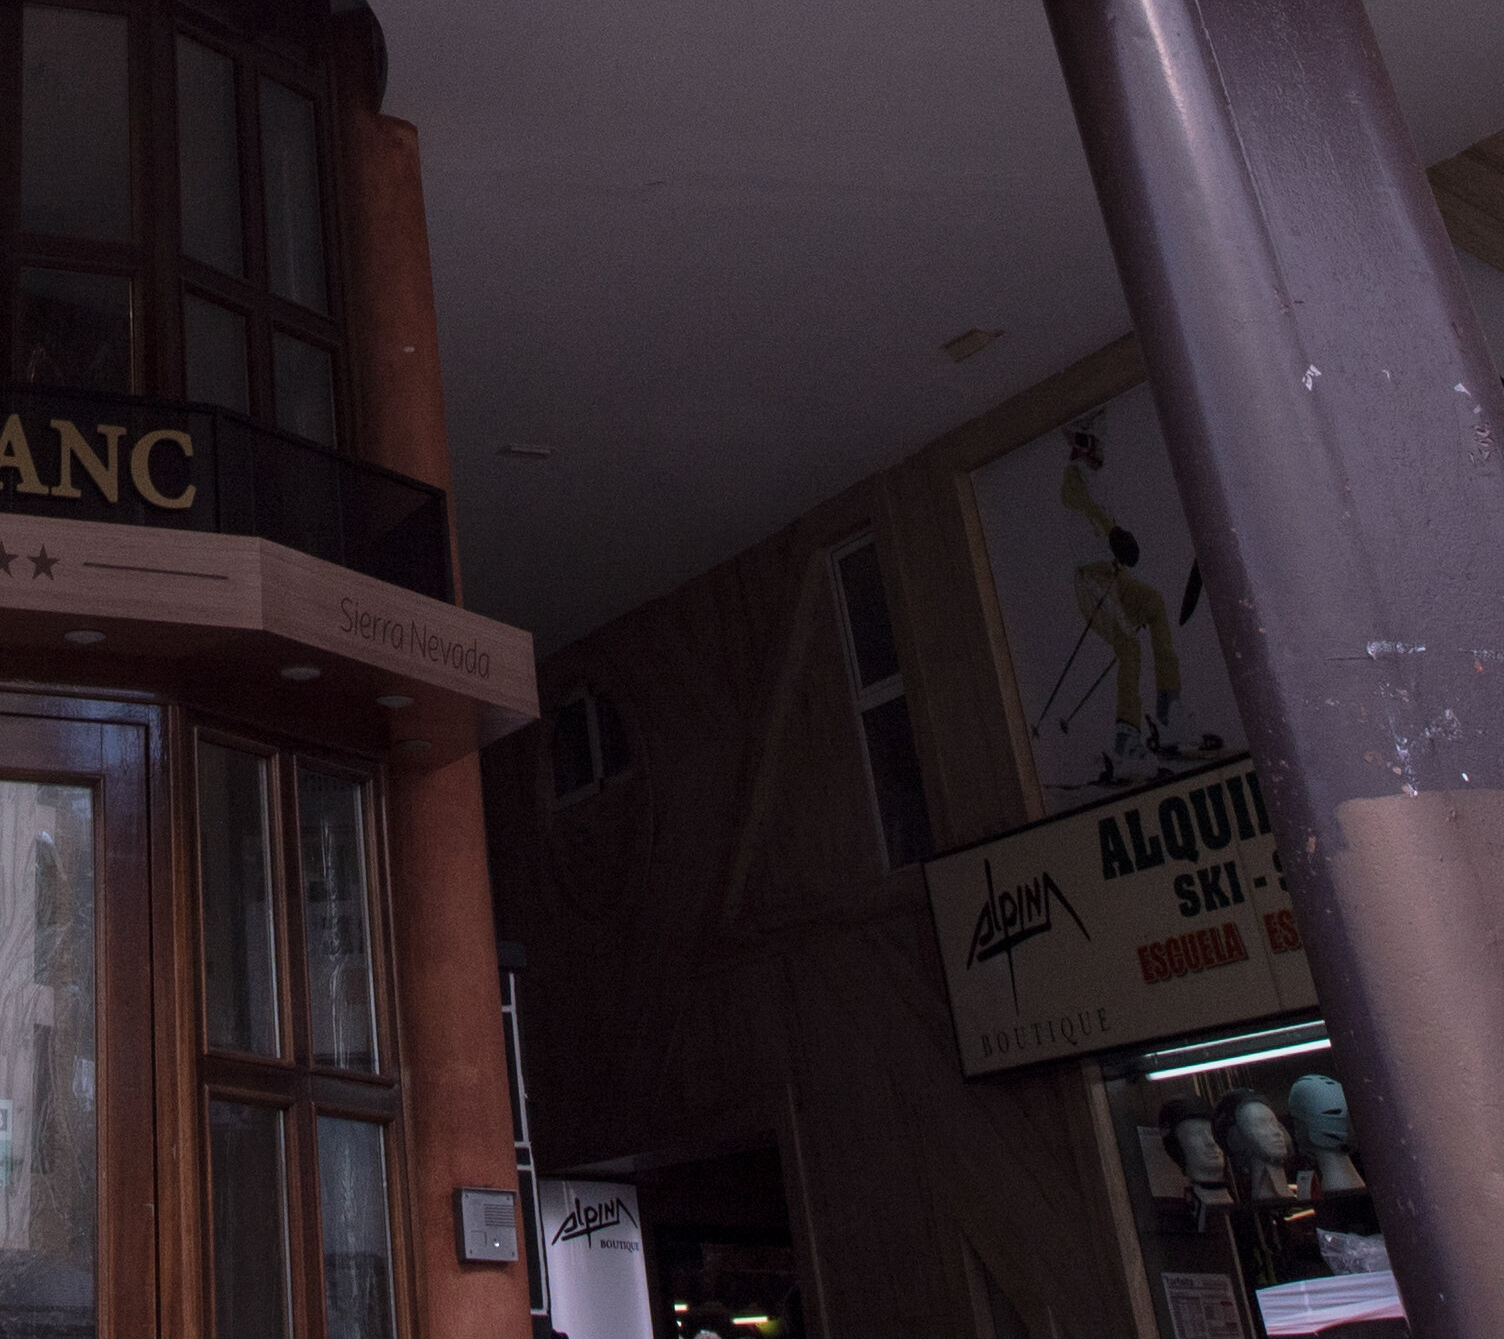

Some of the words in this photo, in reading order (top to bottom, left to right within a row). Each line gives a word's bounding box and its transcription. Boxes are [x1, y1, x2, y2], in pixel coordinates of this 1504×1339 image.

[340, 597, 404, 650] Sierra
[410, 620, 490, 679] Nevada
[1173, 860, 1246, 918] SKI
[1136, 921, 1249, 986] ESCUELA
[981, 1007, 1109, 1059] BOUTIQUE
[599, 1239, 641, 1252] BOUTIQUE
